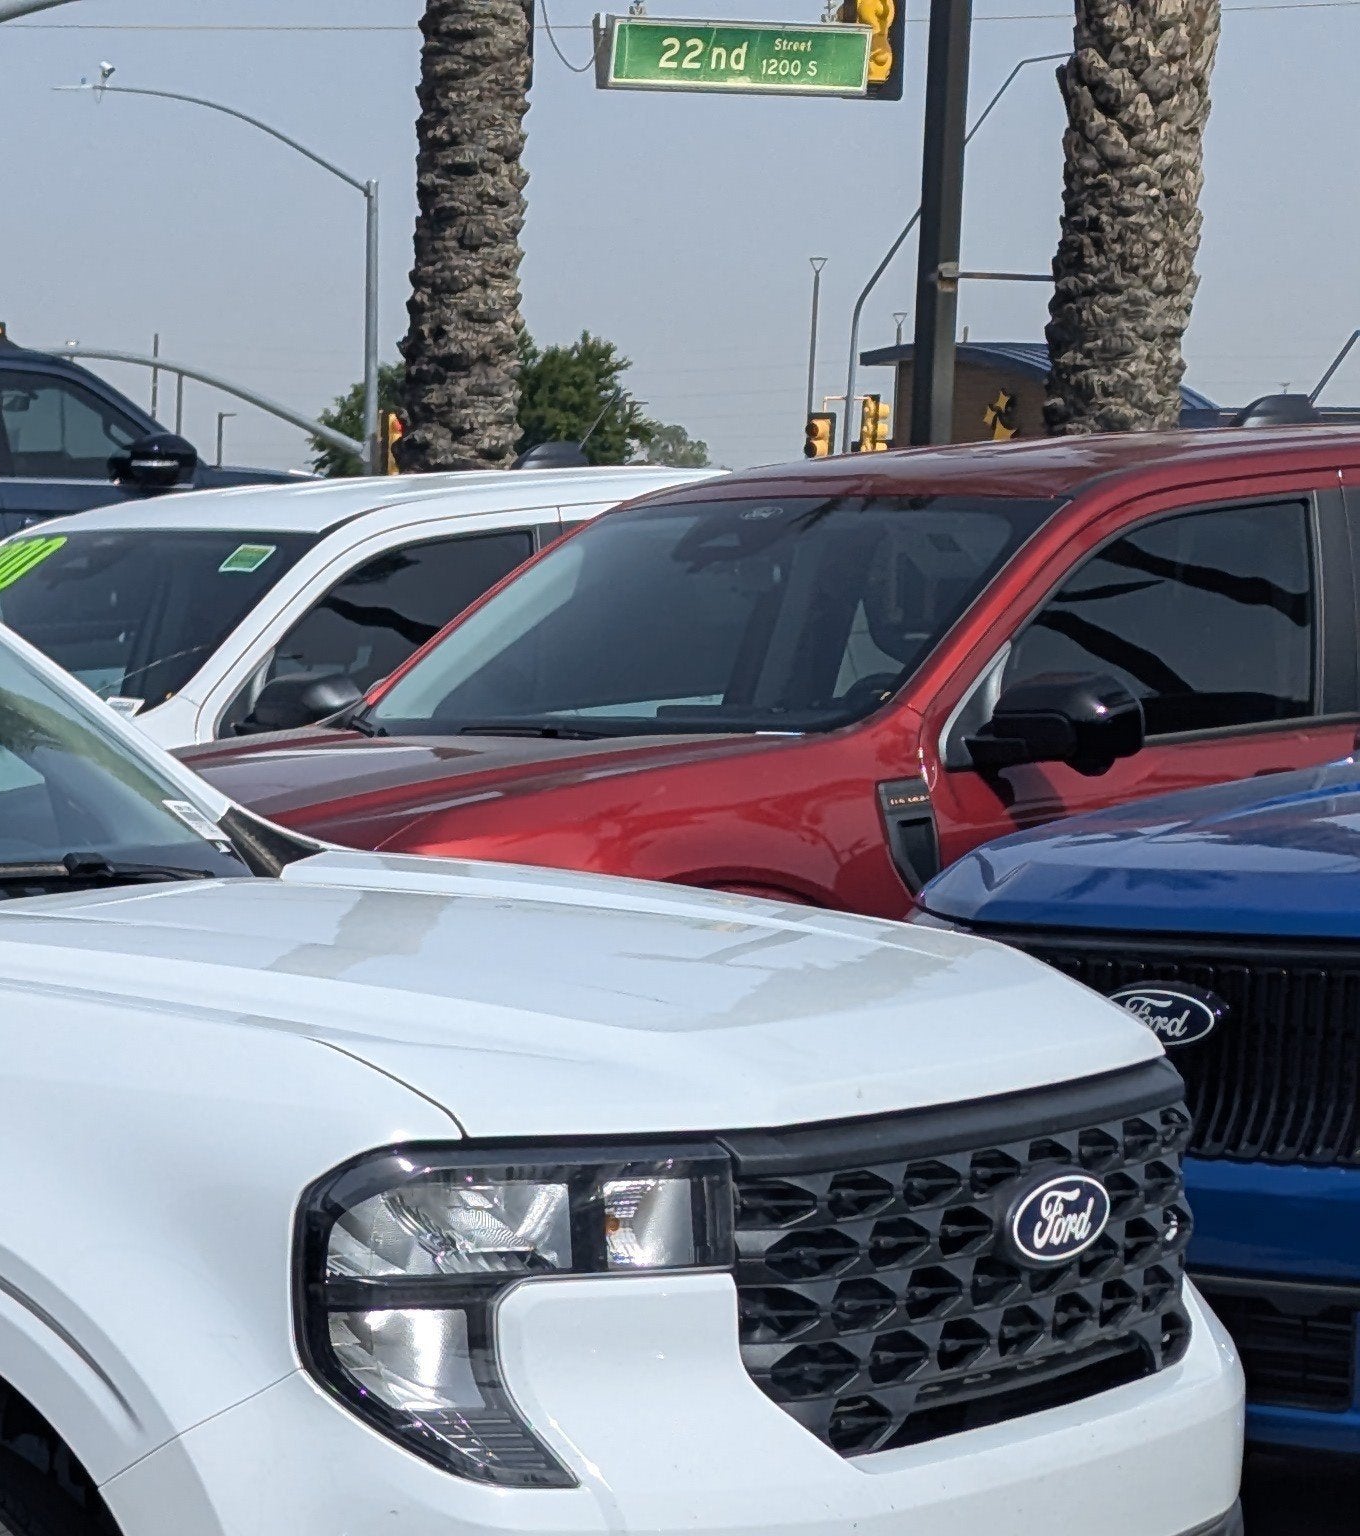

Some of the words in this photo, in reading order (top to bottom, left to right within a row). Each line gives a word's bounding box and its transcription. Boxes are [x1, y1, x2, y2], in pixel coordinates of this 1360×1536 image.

[658, 37, 749, 71] 22nd
[774, 37, 813, 52] Street
[761, 58, 802, 76] 1200
[806, 60, 818, 77] S
[1033, 1187, 1095, 1249] Ford
